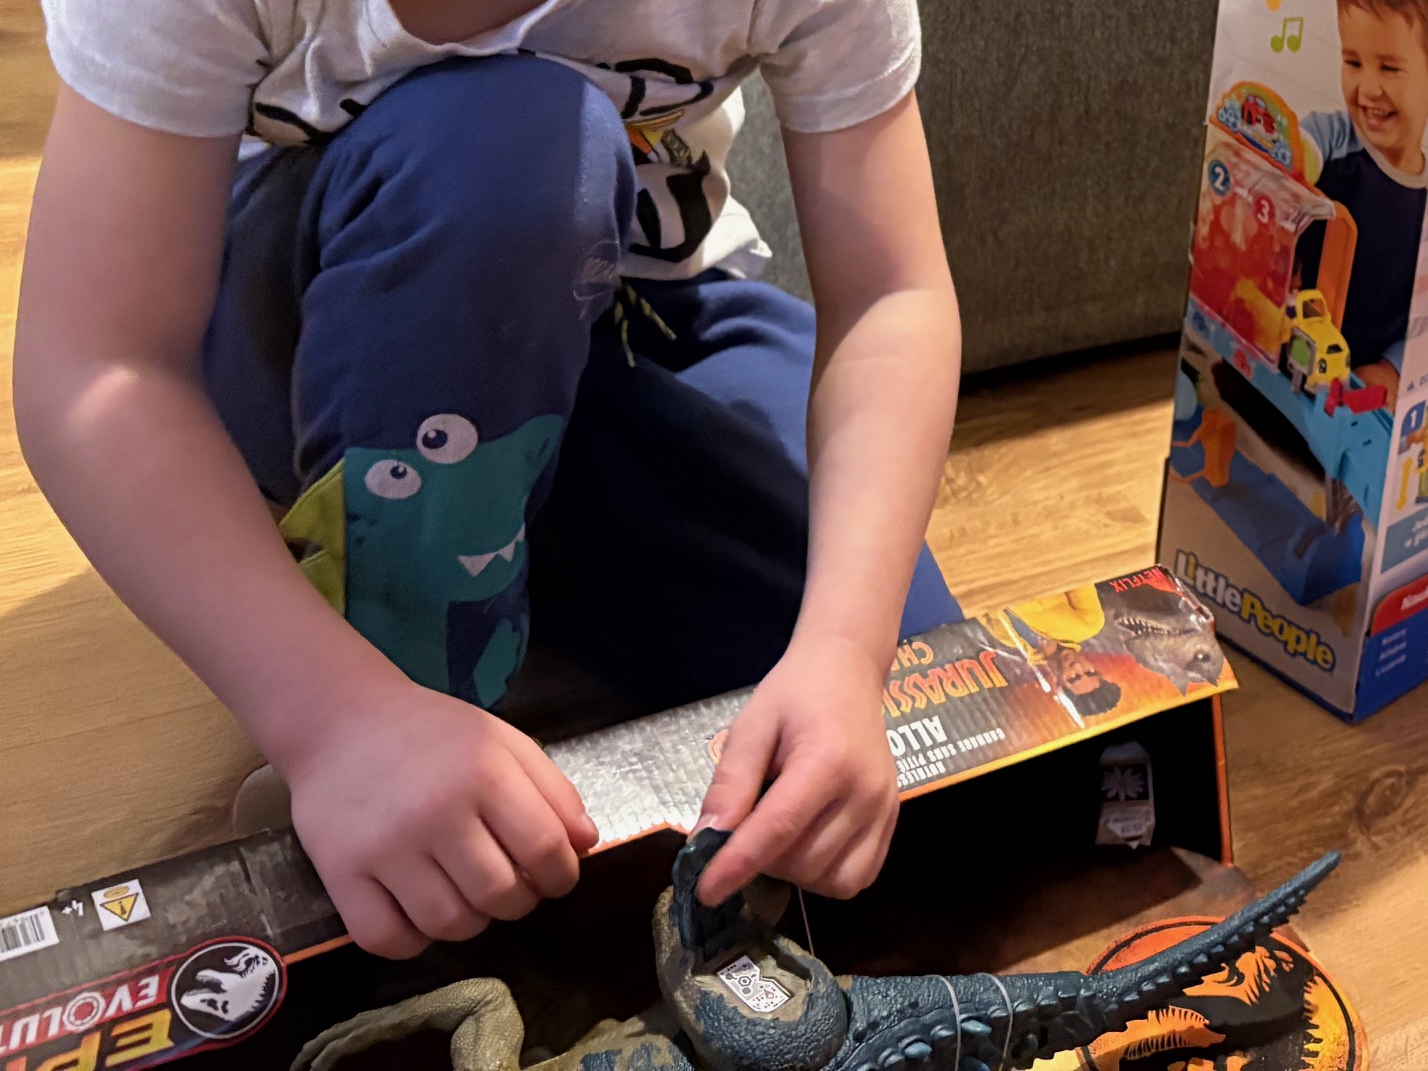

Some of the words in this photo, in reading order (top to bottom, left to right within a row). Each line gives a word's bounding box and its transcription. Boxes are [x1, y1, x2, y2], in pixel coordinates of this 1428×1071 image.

[1213, 167, 1226, 191] 2
[1257, 199, 1270, 224] 3
[882, 650, 1008, 718] JURASSI
[926, 744, 957, 762] SANS
[957, 728, 1006, 753] CARNAGE
[61, 900, 84, 916] 4+
[4, 1009, 174, 1071] EP
